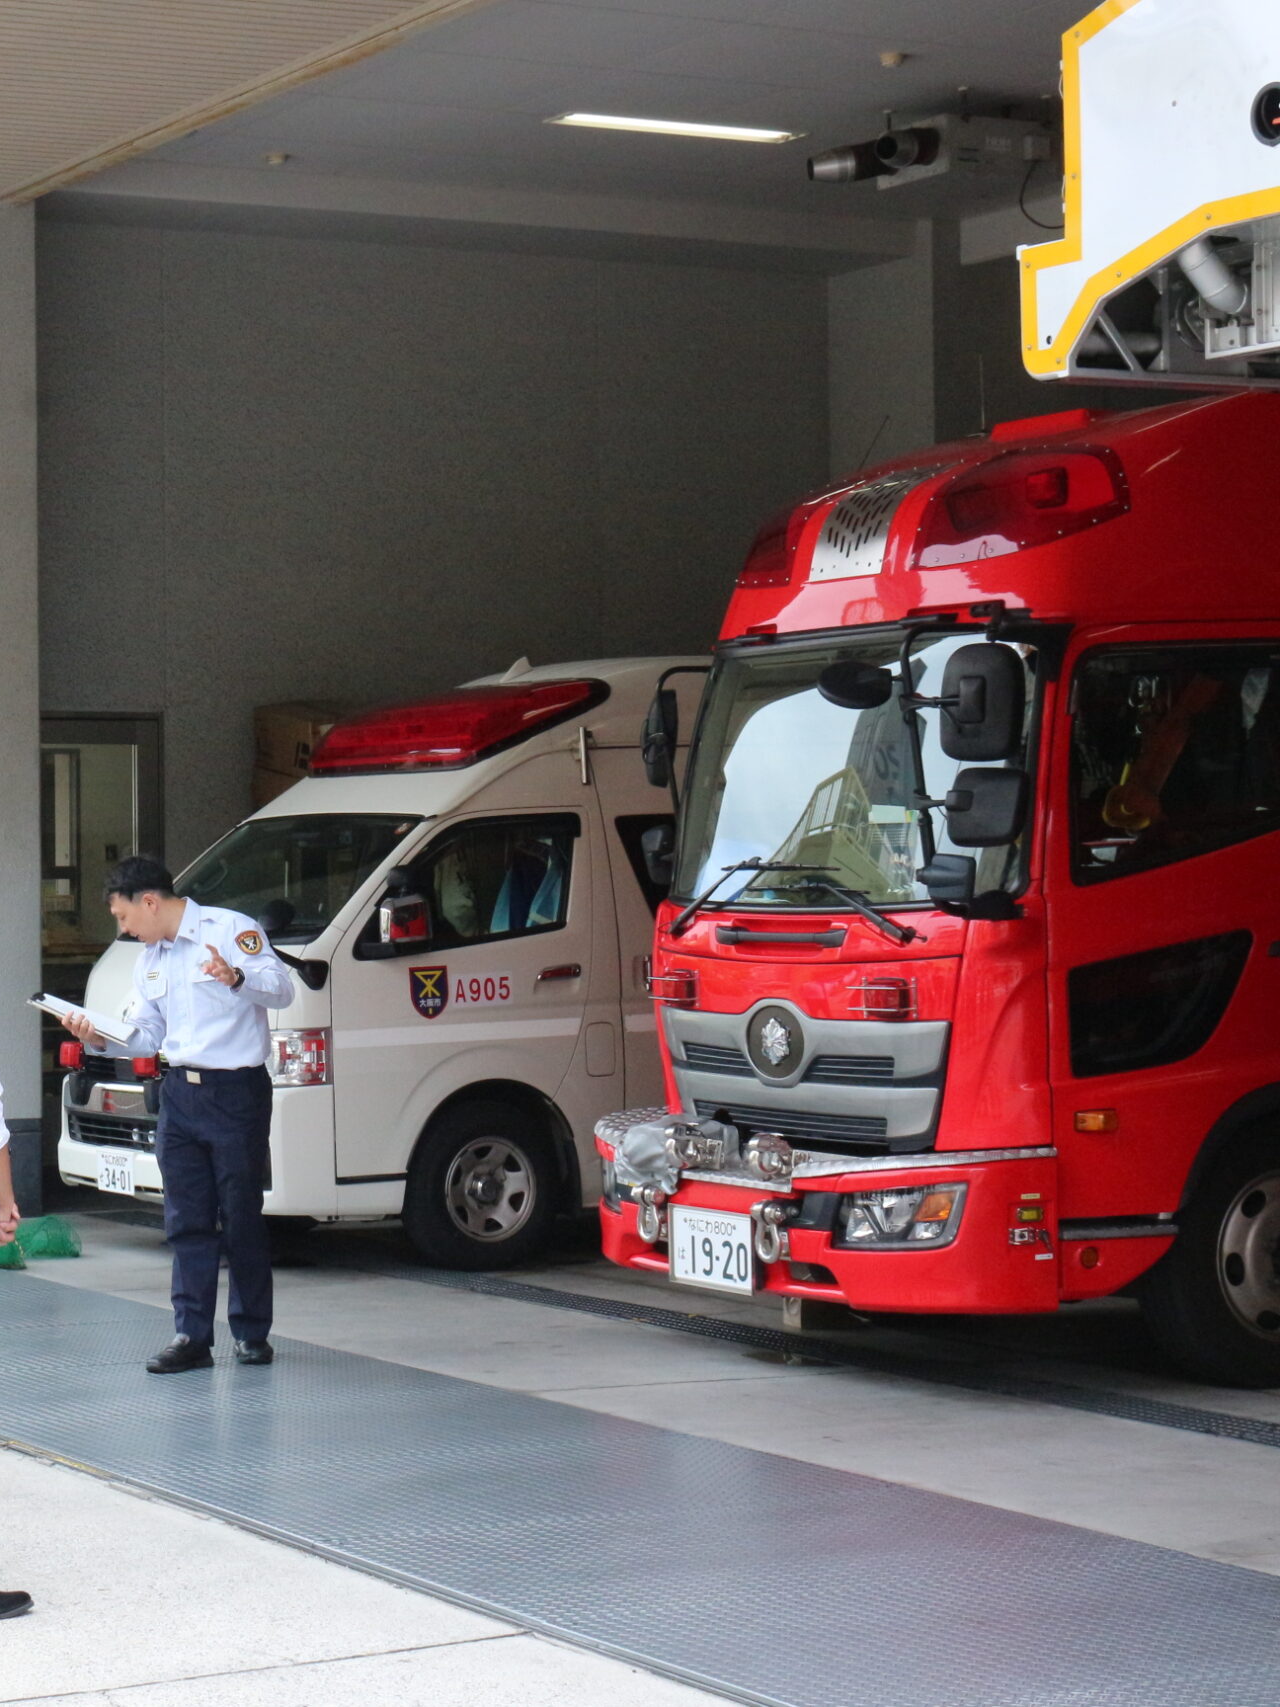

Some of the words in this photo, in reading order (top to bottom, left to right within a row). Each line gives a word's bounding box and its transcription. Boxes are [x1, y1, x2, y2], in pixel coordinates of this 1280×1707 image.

[455, 976, 510, 1003] A905
[419, 998, 442, 1009] 大阪市
